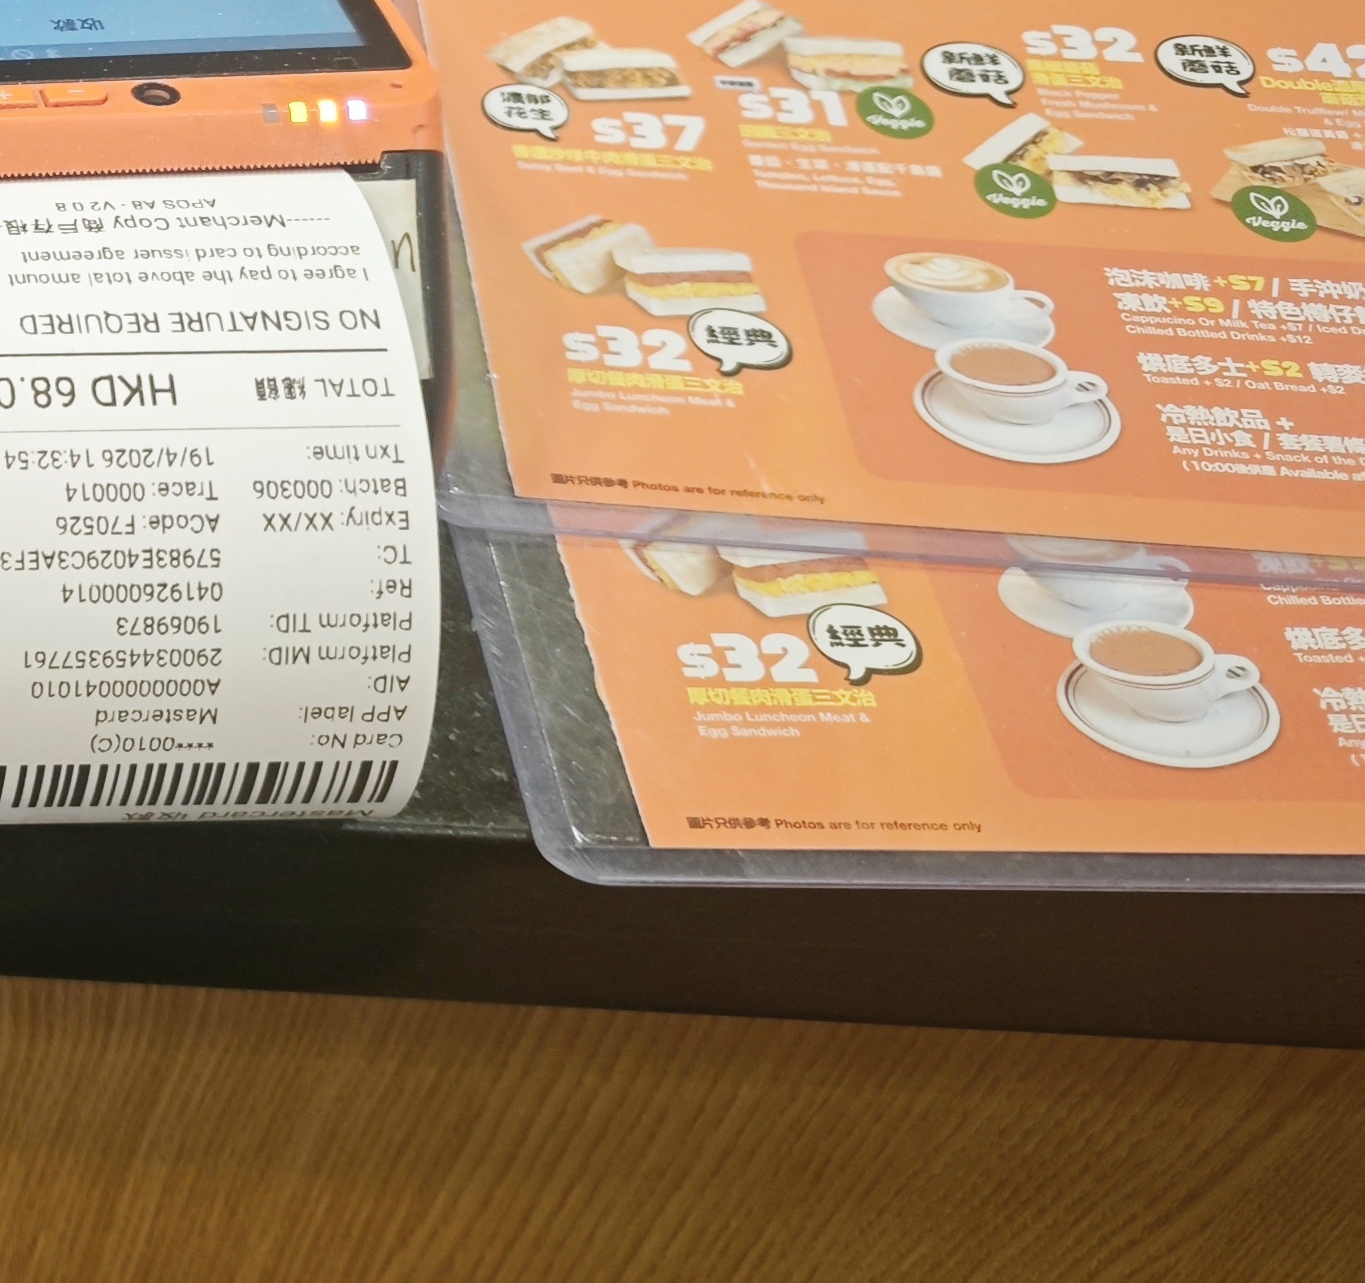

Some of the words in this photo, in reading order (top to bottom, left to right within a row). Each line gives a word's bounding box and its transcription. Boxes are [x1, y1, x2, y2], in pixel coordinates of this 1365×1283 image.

[49, 16, 104, 32] 收款
[1021, 24, 1144, 63] $32
[738, 87, 849, 127] $31
[591, 112, 706, 152] $37
[131, 199, 157, 211] A8
[162, 198, 217, 210] APOS
[986, 192, 1048, 210] Veggie
[111, 214, 170, 232] Copy
[1245, 215, 1308, 233] Veggie
[20, 245, 127, 264] agreement
[133, 248, 191, 264] issuer
[195, 247, 239, 264] card
[243, 247, 262, 262] to
[266, 242, 361, 263] according
[7, 271, 81, 288] amount
[87, 270, 133, 288] total
[136, 269, 196, 286] above
[201, 268, 233, 286] the
[237, 264, 273, 281] pay
[278, 268, 298, 283] to
[303, 264, 357, 282] agree
[1103, 267, 1211, 292] 泡沫咖啡
[18, 312, 160, 335] REQUIRED
[167, 310, 330, 333] SIGNATURE
[339, 309, 381, 330] NO
[1121, 313, 1196, 327] Cappucino
[1199, 317, 1215, 327] Or
[1221, 318, 1249, 330] Milk
[1253, 320, 1277, 331] Tea
[1318, 324, 1349, 335] Iced
[705, 324, 779, 348] 經典
[1125, 325, 1174, 337] Chilled
[1177, 328, 1227, 340] Bottled
[1231, 331, 1276, 343] Drinks
[562, 324, 693, 373] $32
[91, 373, 177, 407] HKD
[253, 376, 307, 401] 總額
[313, 375, 396, 398] TOTAL
[1141, 373, 1200, 386] Toasted
[1245, 380, 1270, 391] Oat
[1274, 382, 1318, 394] Bread
[1156, 403, 1271, 431] 冷熱飲品
[1166, 426, 1256, 448] 是日小食
[2, 448, 96, 470] 14:32:54
[102, 446, 215, 468] 19/4/2026
[305, 443, 358, 464] time:
[362, 442, 404, 464] Txn
[1172, 445, 1199, 458] Any
[1203, 447, 1250, 460] Drinks
[1265, 451, 1310, 464] Snack
[1315, 454, 1328, 465] of
[1332, 455, 1356, 466] the
[1280, 466, 1349, 482] Available
[64, 481, 146, 502] 000014
[150, 480, 218, 501] Trace:
[252, 478, 333, 499] 000306
[338, 477, 407, 498] Batch:
[632, 480, 680, 493] Photos
[683, 484, 703, 495] are
[707, 485, 726, 496] for
[730, 488, 793, 502] reference
[797, 494, 825, 505] only
[55, 515, 135, 535] F70526
[141, 513, 219, 534] ACode:
[261, 511, 334, 532] XX/XX
[339, 507, 411, 531] Expiry:
[0, 548, 222, 571] 57983E4029C3AEF3
[376, 545, 411, 565] TC:
[60, 581, 224, 603] 041926000014
[369, 578, 412, 599] Ref:
[1267, 594, 1318, 606] Chilled
[115, 615, 223, 635] 19069873
[268, 614, 312, 633] TID:
[318, 612, 412, 633] Platform
[826, 624, 908, 648] 經典
[22, 647, 223, 669] 290034459357761
[261, 645, 311, 665] MID:
[318, 643, 412, 664] Platform
[677, 632, 819, 684] $32
[1293, 652, 1355, 664] Toasted
[31, 678, 221, 698] A0000000041010
[366, 675, 411, 694] AID:
[94, 708, 219, 726] Mastercard
[298, 705, 355, 723] label:
[360, 705, 407, 722] APP
[693, 711, 743, 723] Jumbo
[746, 712, 816, 724] Luncheon
[820, 712, 856, 724] Meat
[309, 732, 348, 749] No:
[354, 732, 403, 749] Card
[698, 725, 728, 739] Egg
[732, 725, 800, 738] Sandwich
[775, 818, 824, 830] Photos
[829, 820, 851, 830] are
[855, 819, 875, 830] for
[880, 819, 948, 831] reference
[953, 820, 982, 833] only
